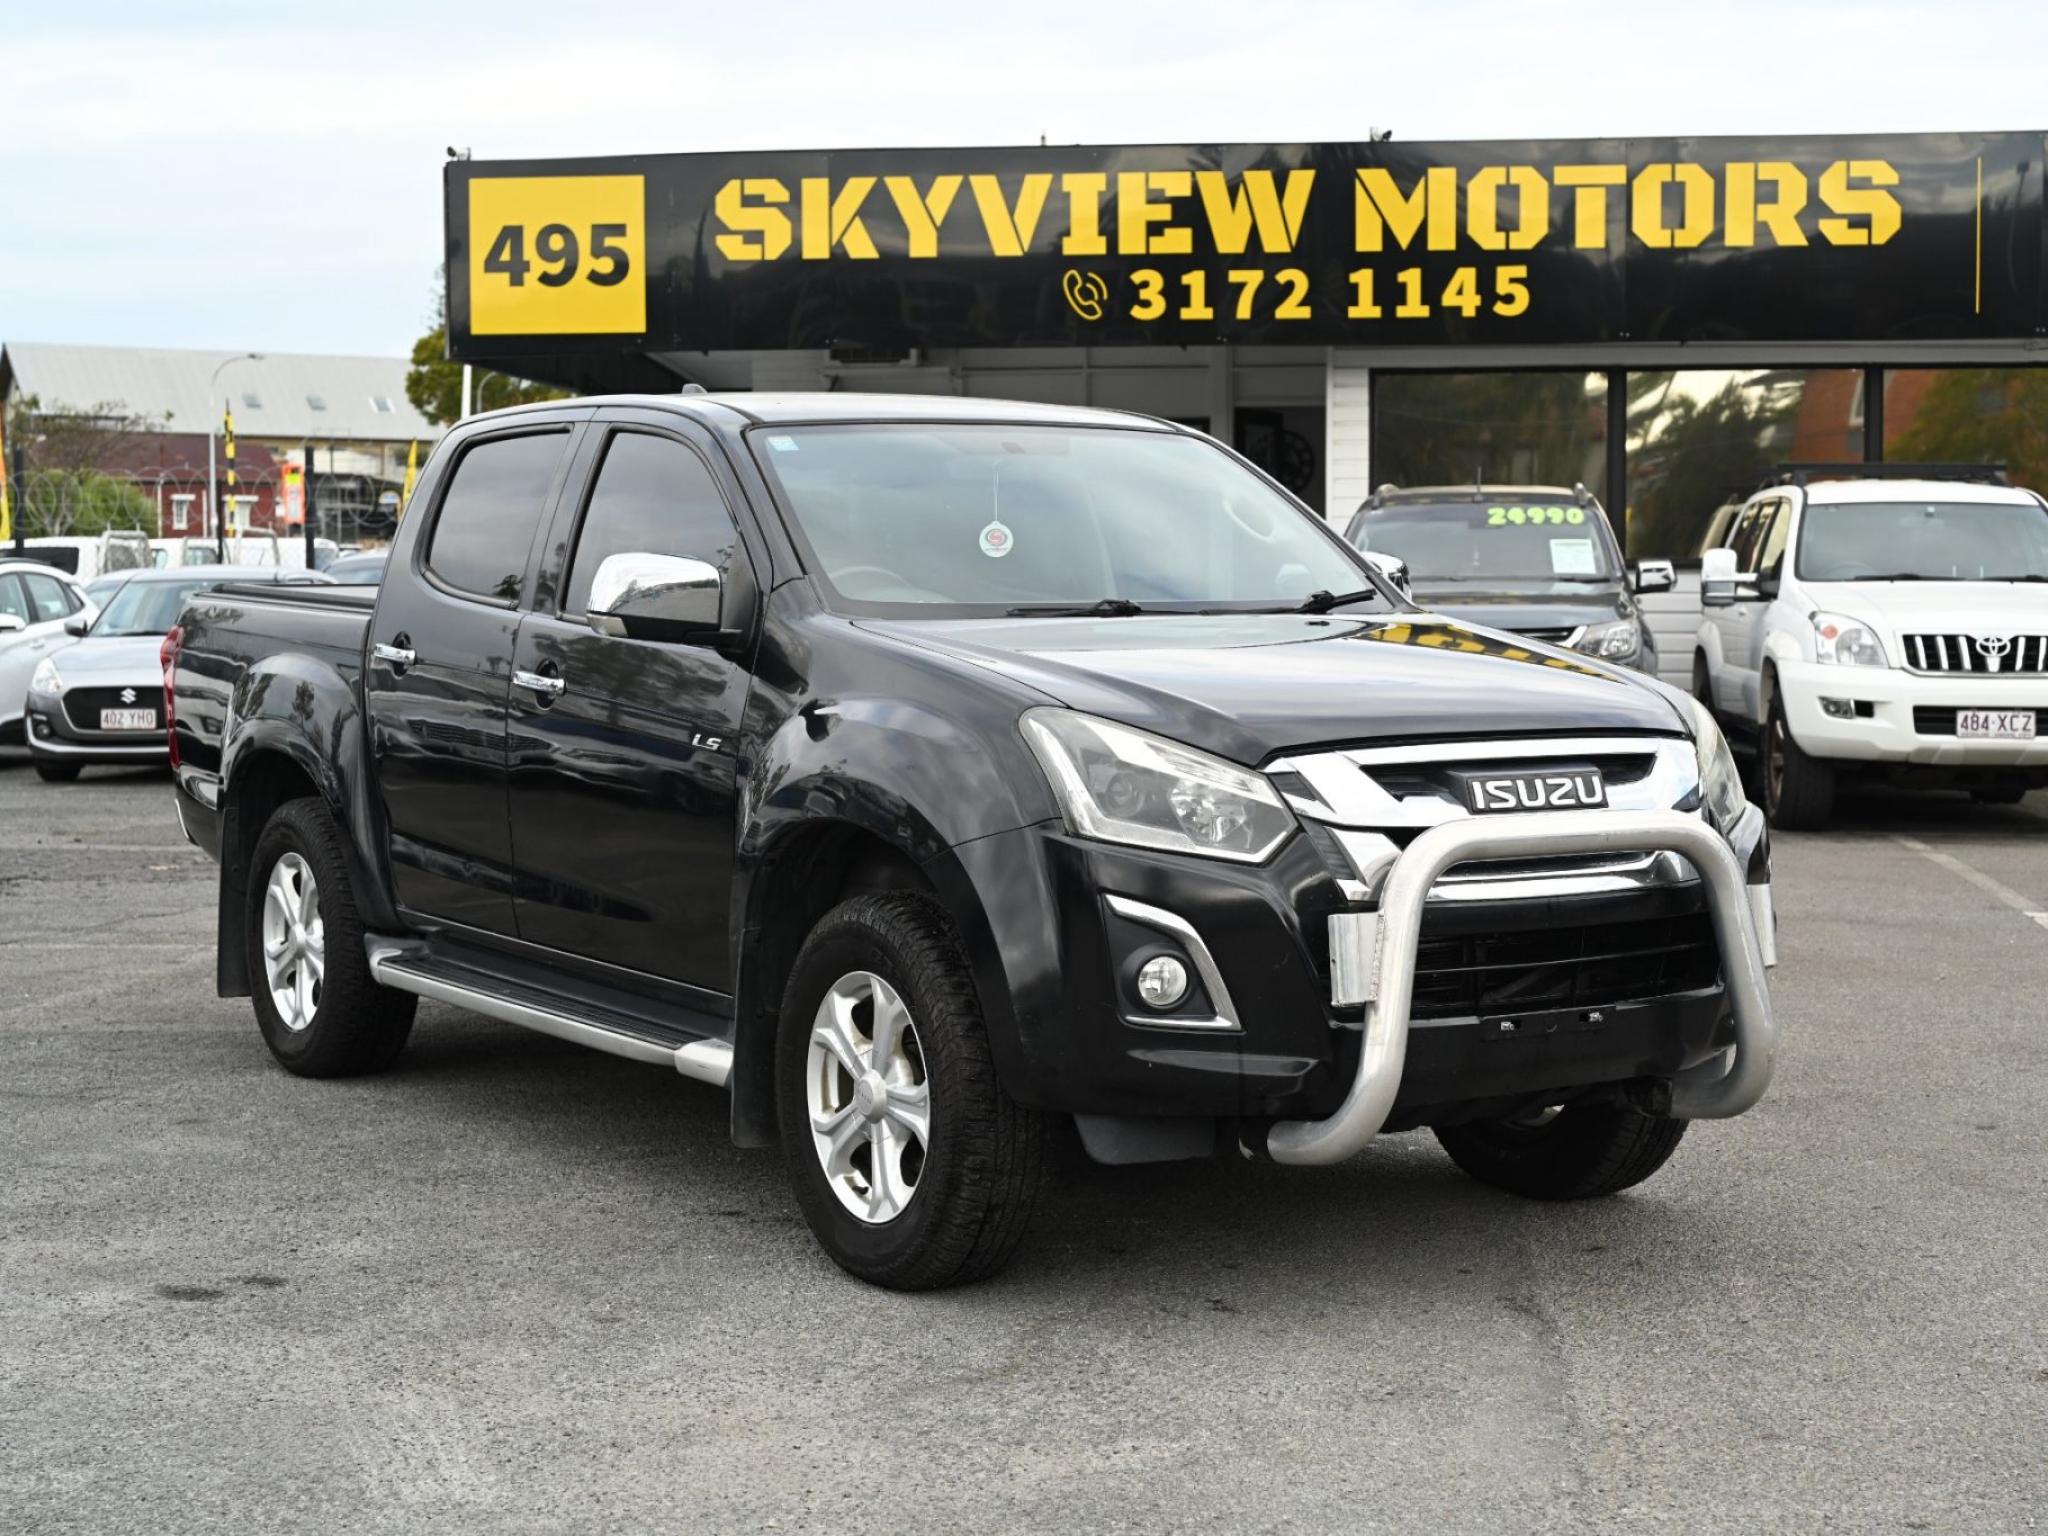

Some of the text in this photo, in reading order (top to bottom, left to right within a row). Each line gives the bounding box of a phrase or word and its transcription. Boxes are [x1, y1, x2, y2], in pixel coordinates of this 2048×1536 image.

[714, 159, 1903, 262] SKYVIEW MOTORS
[484, 223, 630, 287] 495
[1130, 264, 1531, 321] 3172 1145
[1487, 506, 1584, 525] 24990
[1472, 775, 1604, 809] ISUZU
